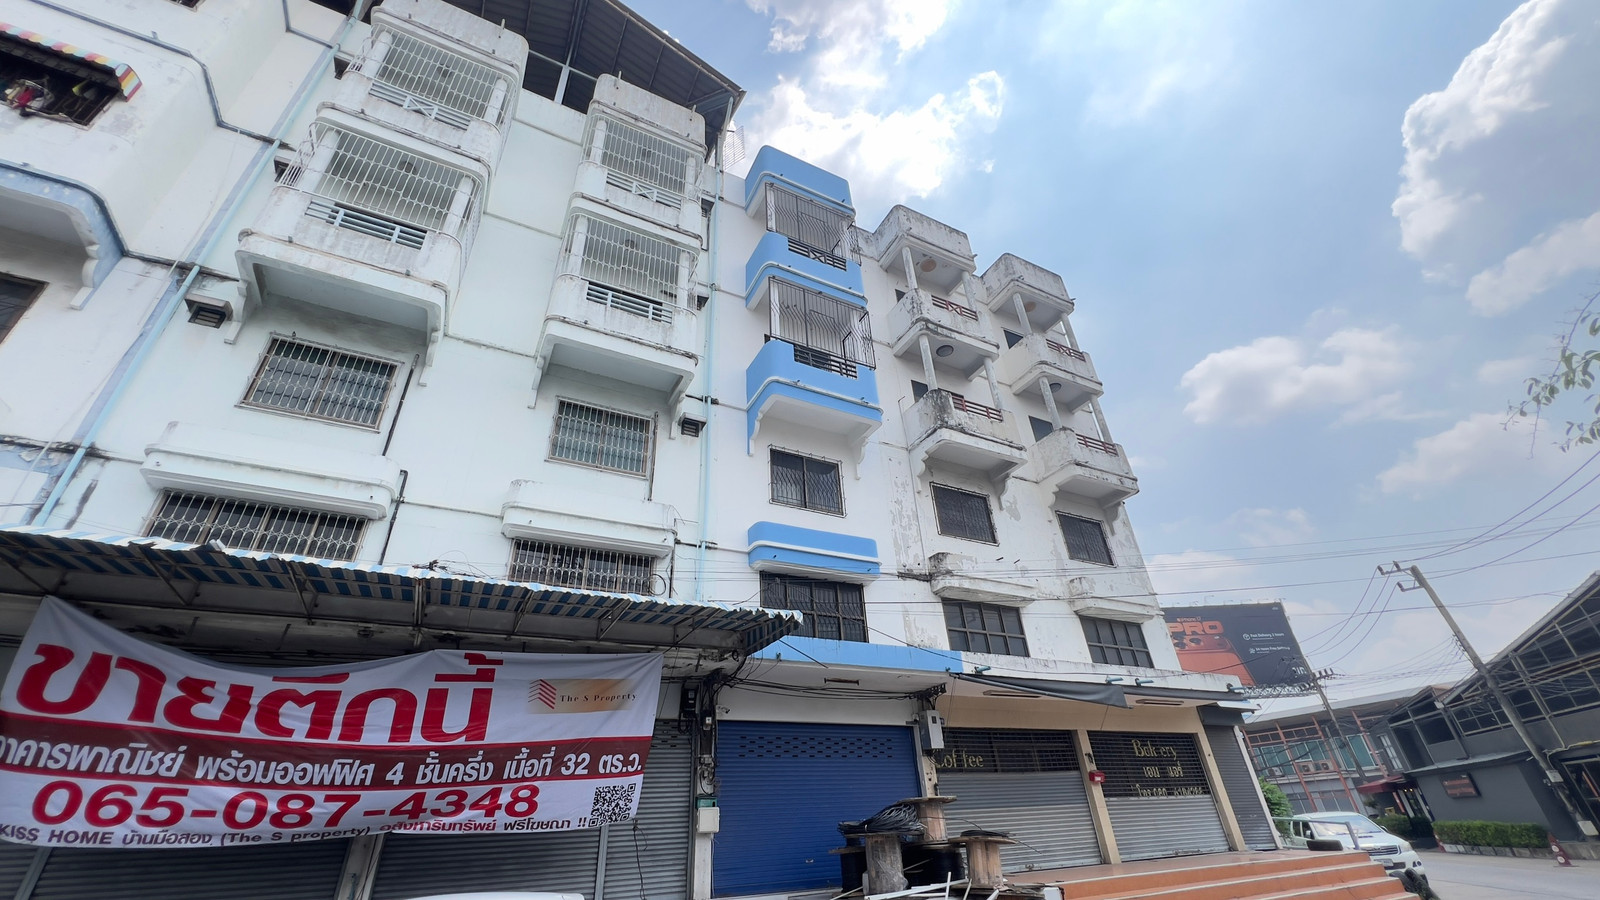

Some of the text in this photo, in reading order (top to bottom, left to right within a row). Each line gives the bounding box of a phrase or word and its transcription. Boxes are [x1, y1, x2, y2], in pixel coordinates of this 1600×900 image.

[1166, 621, 1224, 635] PRO
[594, 693, 637, 702] Property
[194, 750, 376, 786] พร้อมออฟฟิศ
[385, 762, 405, 785] 4
[415, 750, 494, 785] ชั้นครึ่ง
[503, 746, 556, 780] เนื้อที่
[561, 752, 590, 775] 32
[598, 753, 642, 774] ตร.ว.
[32, 780, 540, 828] 065-087-4348
[504, 817, 570, 831] ฟรีโฆษณา
[577, 817, 587, 827] !!
[0, 823, 40, 842] KISS
[48, 829, 114, 845] HOME
[220, 832, 262, 846] (The
[271, 832, 283, 841] S
[291, 826, 371, 842] property)
